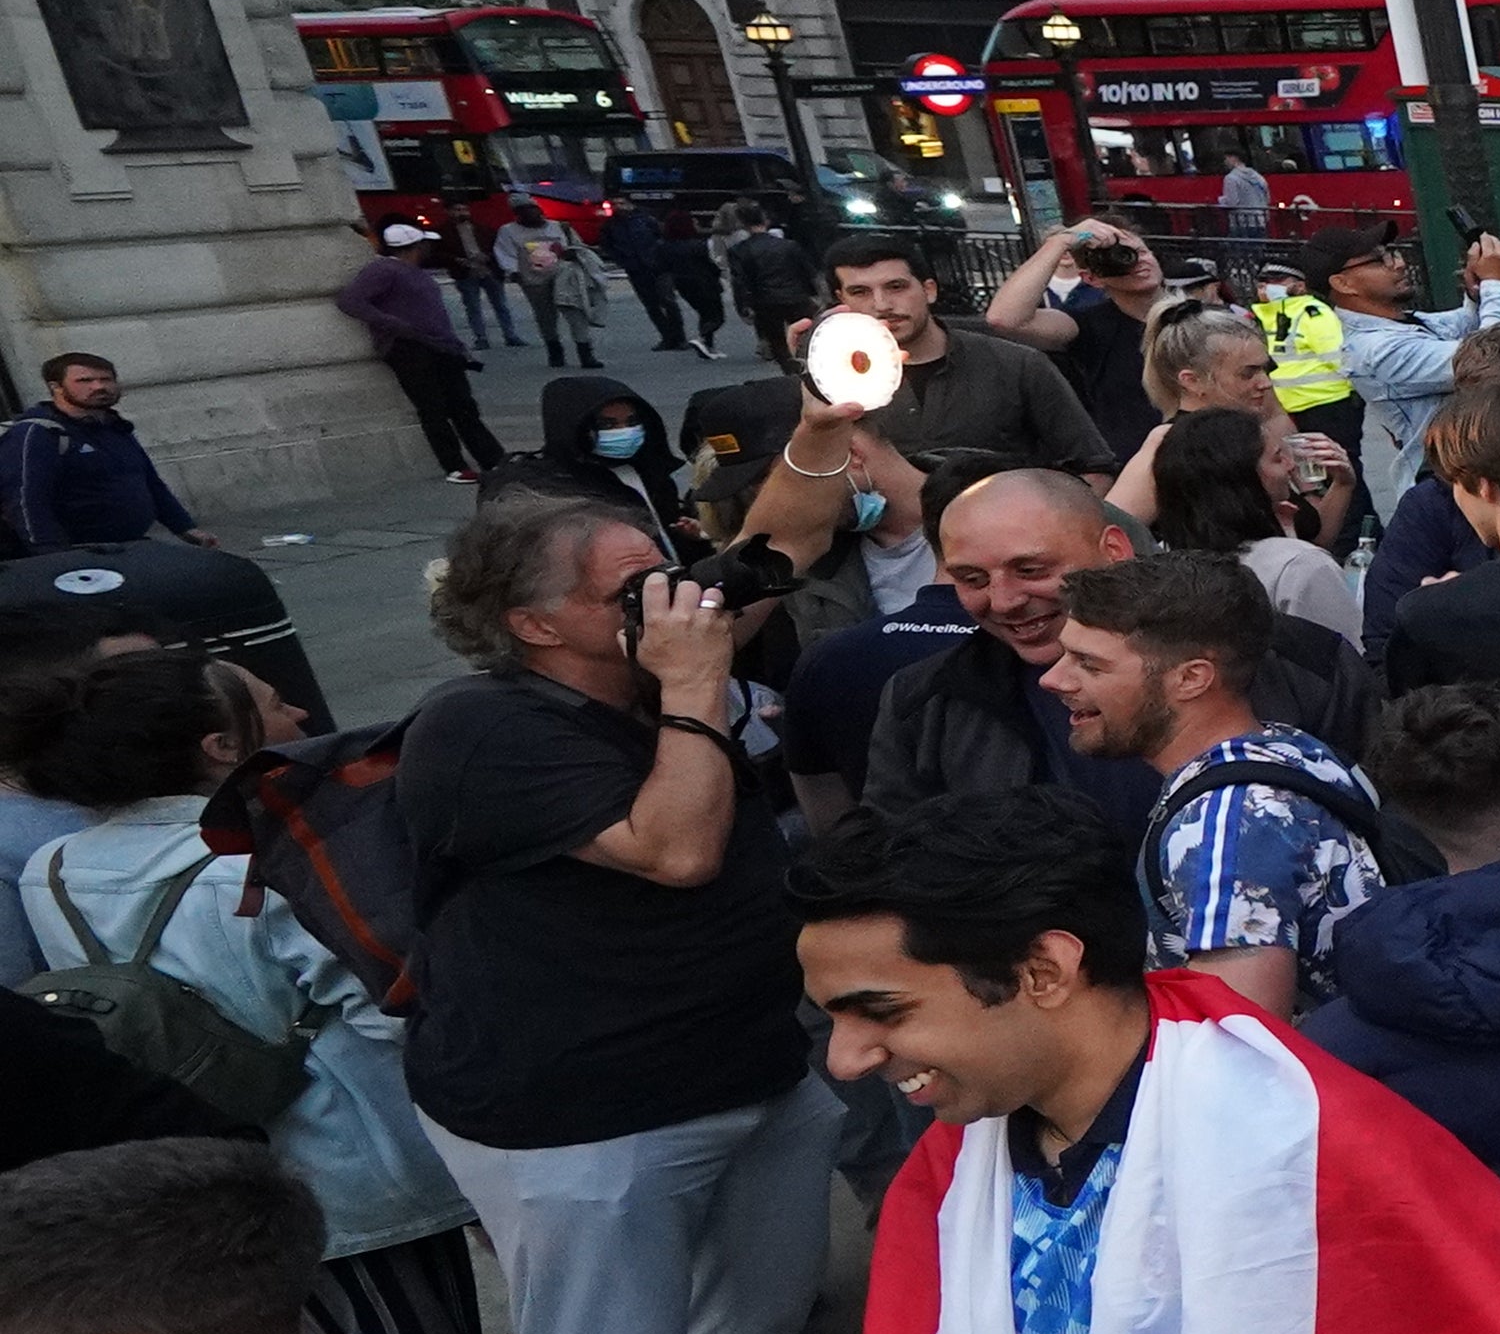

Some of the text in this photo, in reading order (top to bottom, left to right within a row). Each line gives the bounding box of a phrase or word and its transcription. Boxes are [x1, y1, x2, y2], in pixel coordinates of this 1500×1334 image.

[901, 70, 986, 92] UNDERGROUND
[595, 90, 613, 108] 6
[1098, 81, 1151, 105] 10/10
[1152, 82, 1174, 101] IN
[1175, 81, 1200, 101] 10
